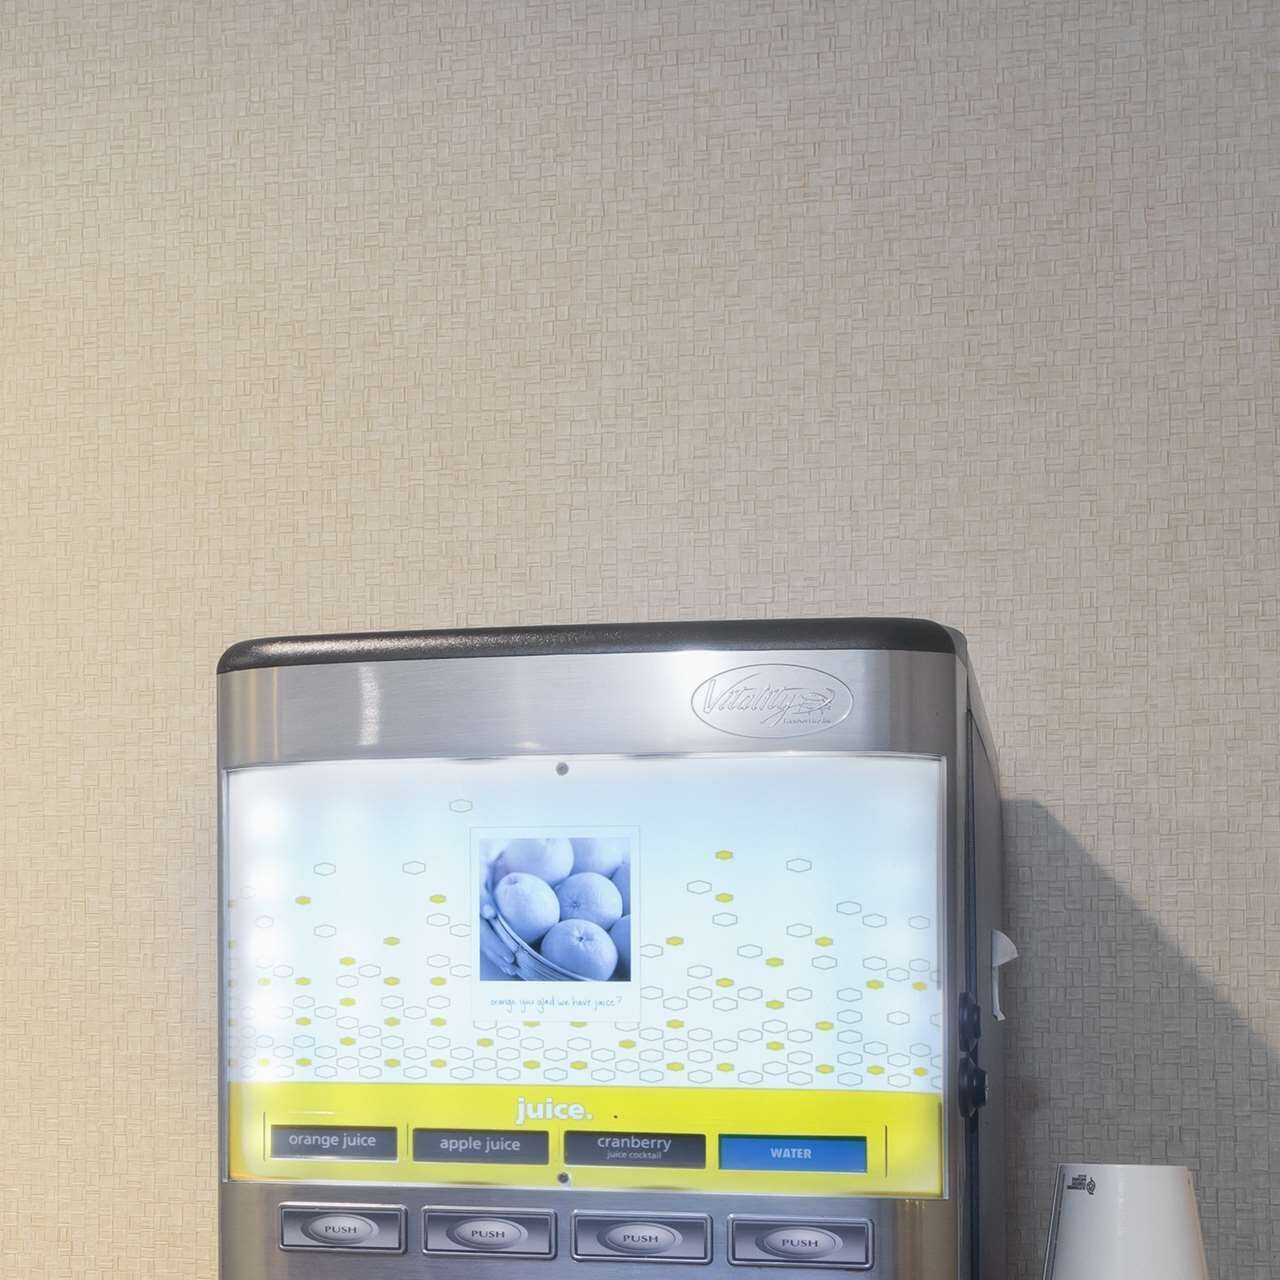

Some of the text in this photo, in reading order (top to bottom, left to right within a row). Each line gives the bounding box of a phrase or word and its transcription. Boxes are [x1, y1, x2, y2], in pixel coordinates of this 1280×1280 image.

[515, 1097, 593, 1124] juice.
[289, 1132, 376, 1148] orange juice
[439, 1136, 521, 1152] apple juice
[597, 1135, 672, 1152] cranberry
[606, 1150, 662, 1160] juice cocktail
[770, 1148, 812, 1160] WATER
[324, 1225, 358, 1234] PUSH
[471, 1230, 505, 1239] PUSH
[623, 1234, 659, 1243] PUSH
[781, 1239, 819, 1248] PUSH
